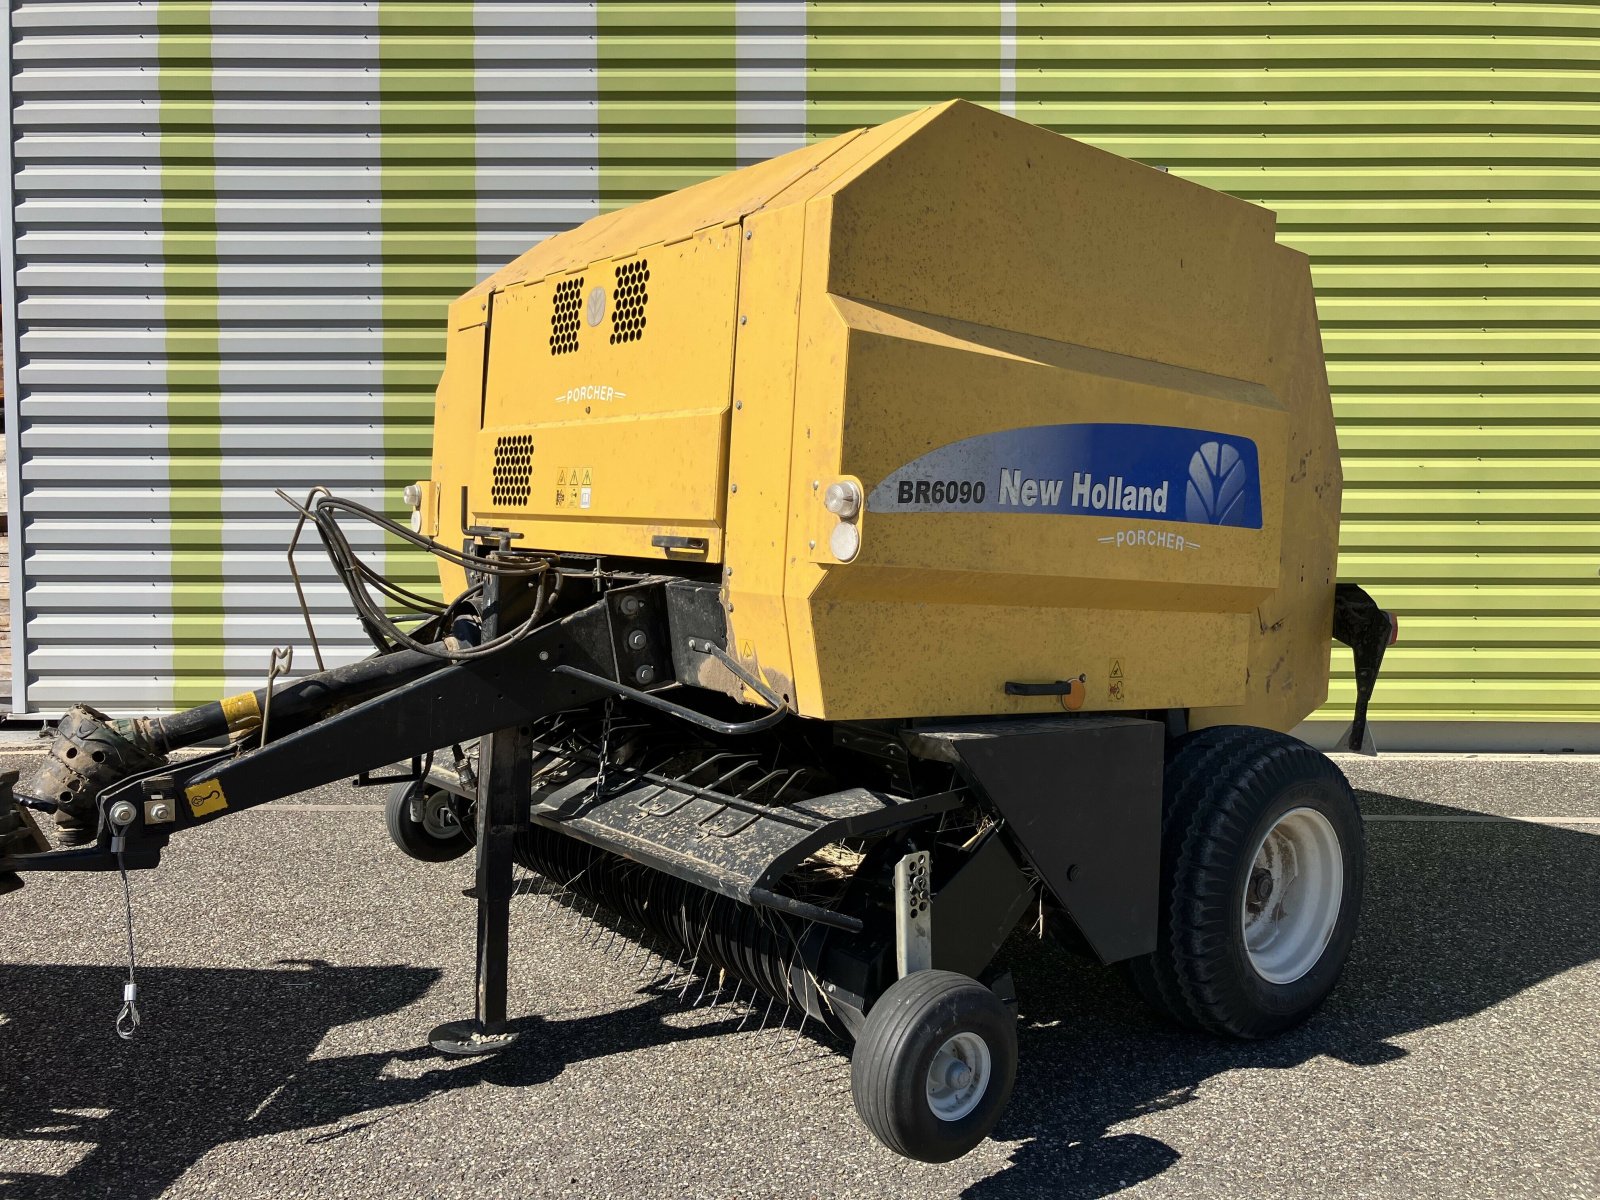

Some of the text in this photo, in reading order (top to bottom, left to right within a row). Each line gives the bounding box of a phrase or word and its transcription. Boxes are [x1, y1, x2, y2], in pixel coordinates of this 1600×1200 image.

[567, 385, 614, 402] PORCHER
[898, 480, 985, 504] BR6090
[998, 468, 1169, 513] New Holland
[1116, 530, 1185, 551] PORCHER
